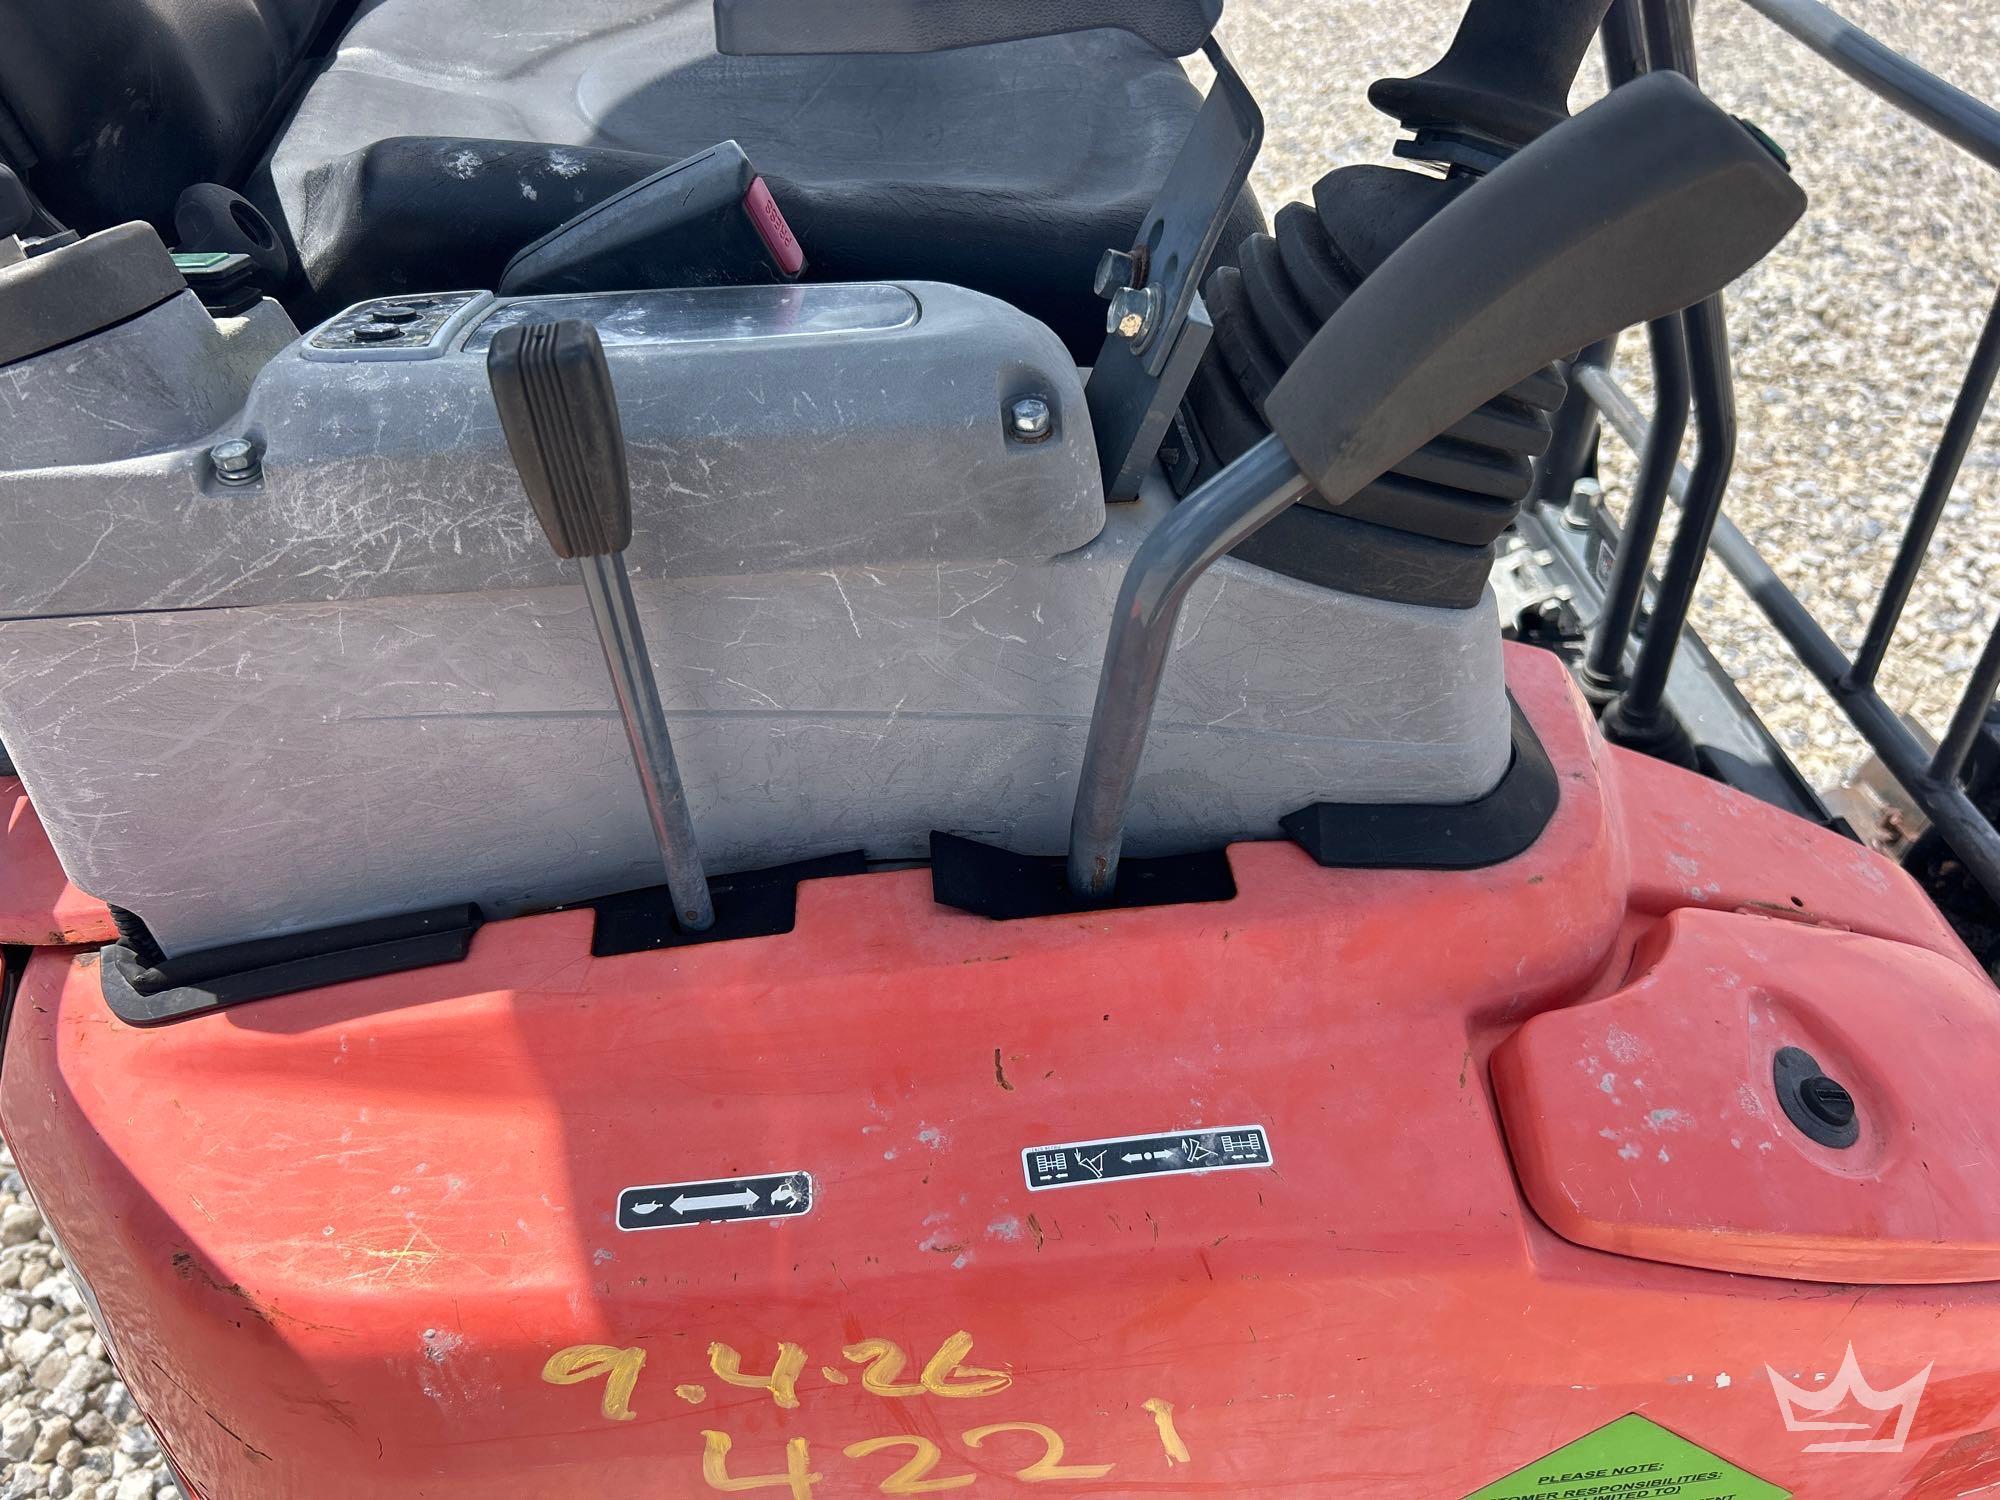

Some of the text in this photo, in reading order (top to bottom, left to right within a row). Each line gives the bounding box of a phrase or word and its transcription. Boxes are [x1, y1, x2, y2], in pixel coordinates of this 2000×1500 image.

[764, 199, 793, 248] PRESS
[1537, 1462, 1665, 1484] PLEASE NOTE:
[1563, 1471, 1724, 1498] RESPONSIBILITIES:
[1654, 1485, 1682, 1496] TO)
